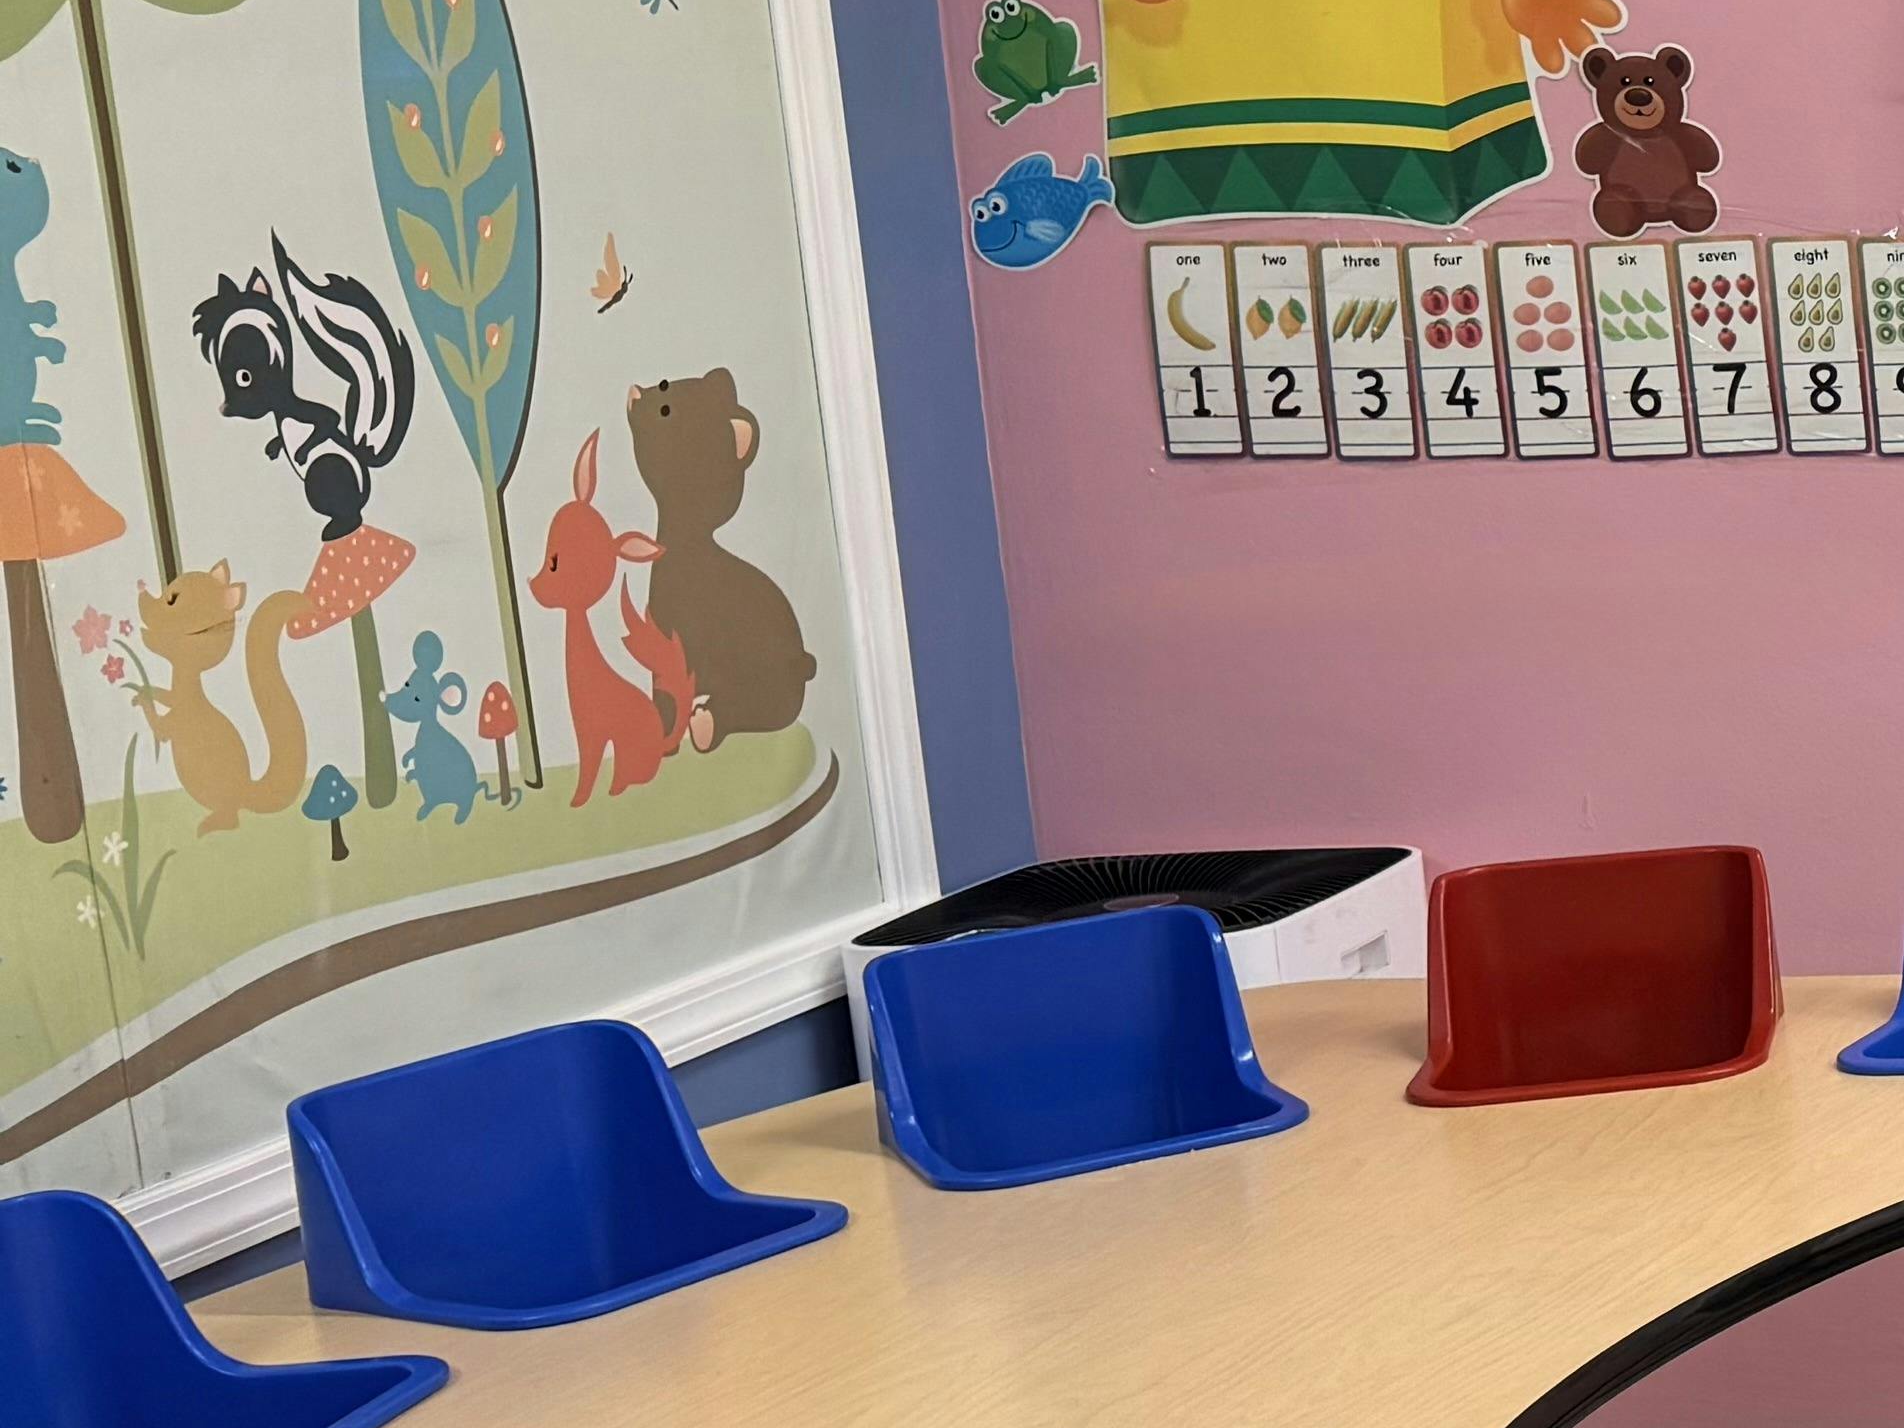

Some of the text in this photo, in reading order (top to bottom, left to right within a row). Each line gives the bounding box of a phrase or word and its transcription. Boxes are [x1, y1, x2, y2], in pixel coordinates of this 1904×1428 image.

[1176, 254, 1201, 266] one
[1261, 253, 1287, 266] two
[1342, 253, 1380, 268] three
[1434, 253, 1462, 267] four
[1524, 252, 1552, 266] five
[1617, 253, 1637, 267] six
[1698, 250, 1737, 262] seven
[1794, 247, 1829, 264] eight
[1189, 366, 1215, 417] 1
[1269, 365, 1300, 416] 2
[1358, 369, 1389, 418] 3
[1445, 366, 1480, 416] 4
[1535, 367, 1569, 419] 5
[1630, 368, 1662, 417] 6
[1712, 363, 1747, 415] 7
[1809, 362, 1841, 414] 8
